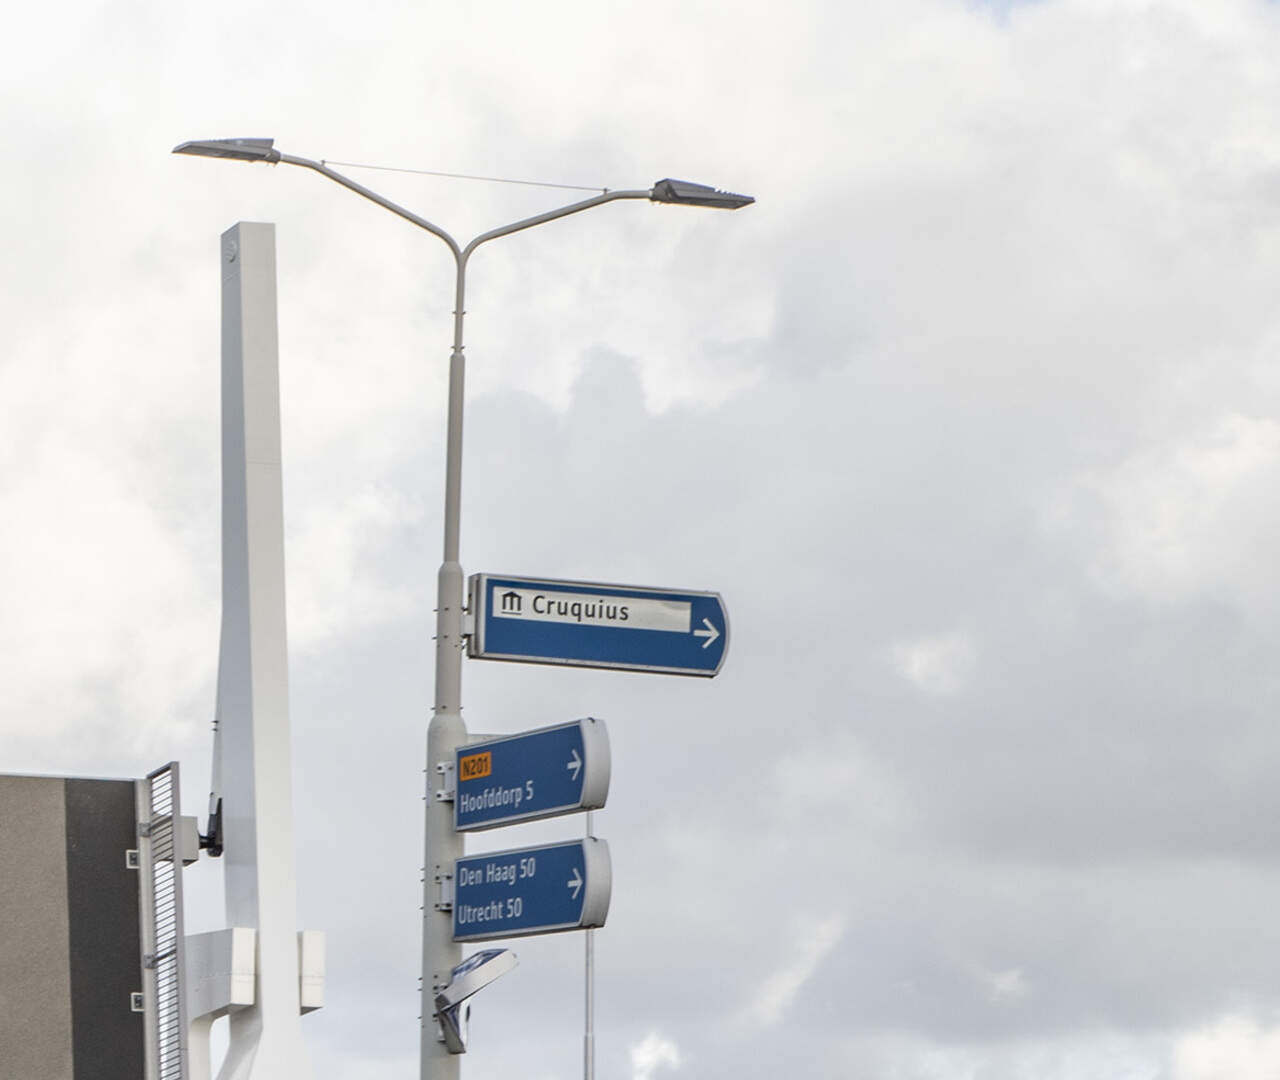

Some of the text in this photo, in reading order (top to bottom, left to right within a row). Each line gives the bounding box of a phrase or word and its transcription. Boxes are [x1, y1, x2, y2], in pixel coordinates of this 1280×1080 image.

[532, 594, 630, 622] Cruquius
[463, 756, 489, 777] N201
[460, 780, 534, 814] Hoofddorp 5
[459, 856, 536, 887] Den Haag 50
[458, 897, 522, 925] Utrecht 50
